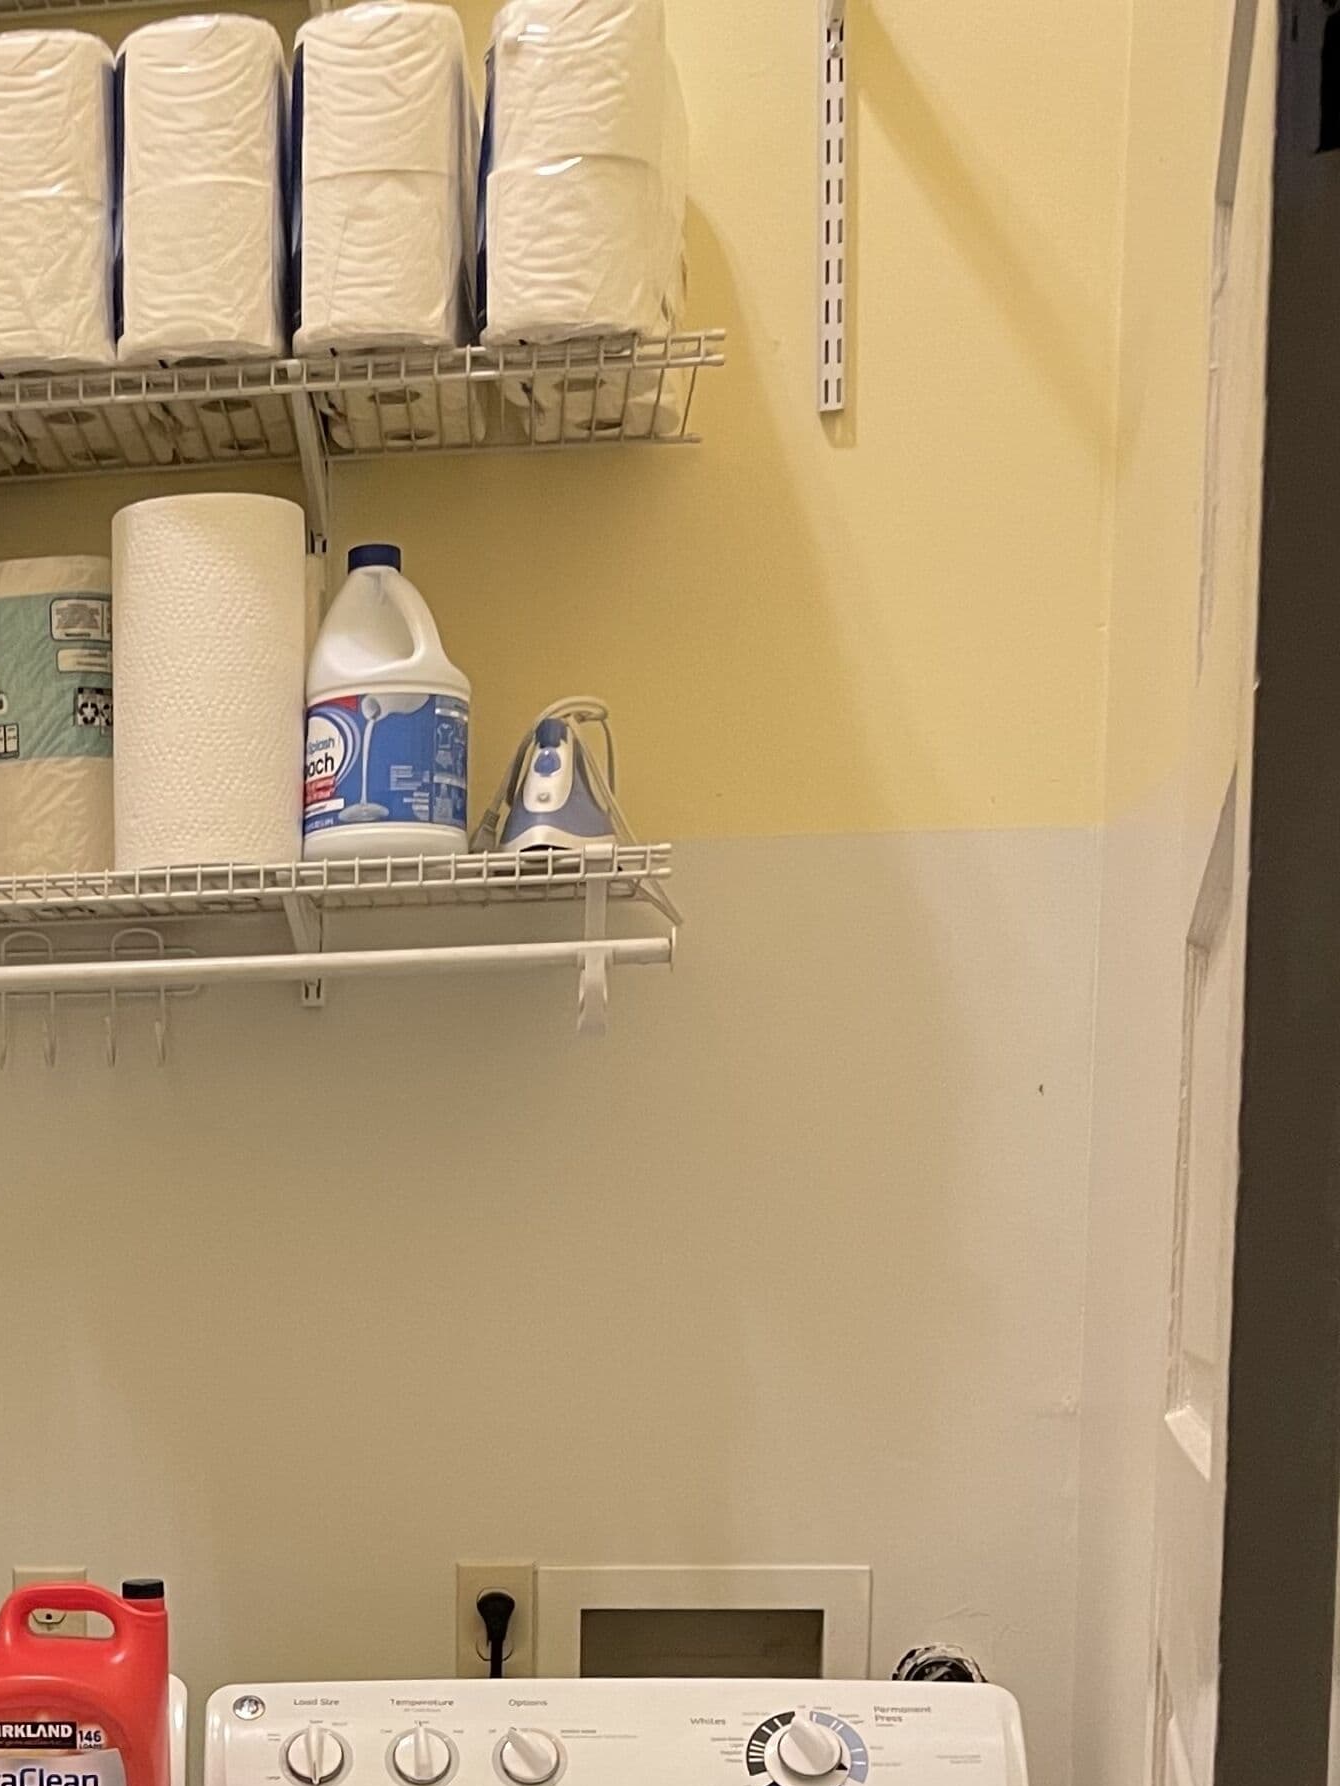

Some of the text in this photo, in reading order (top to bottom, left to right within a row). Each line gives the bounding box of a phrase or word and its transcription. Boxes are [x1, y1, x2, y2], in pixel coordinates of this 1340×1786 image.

[391, 1699, 455, 1708] Temperature
[509, 1699, 548, 1708] Options
[873, 1705, 932, 1714] Permanent
[690, 1717, 726, 1726] Whites
[874, 1715, 903, 1723] Press
[78, 1730, 102, 1743] 146
